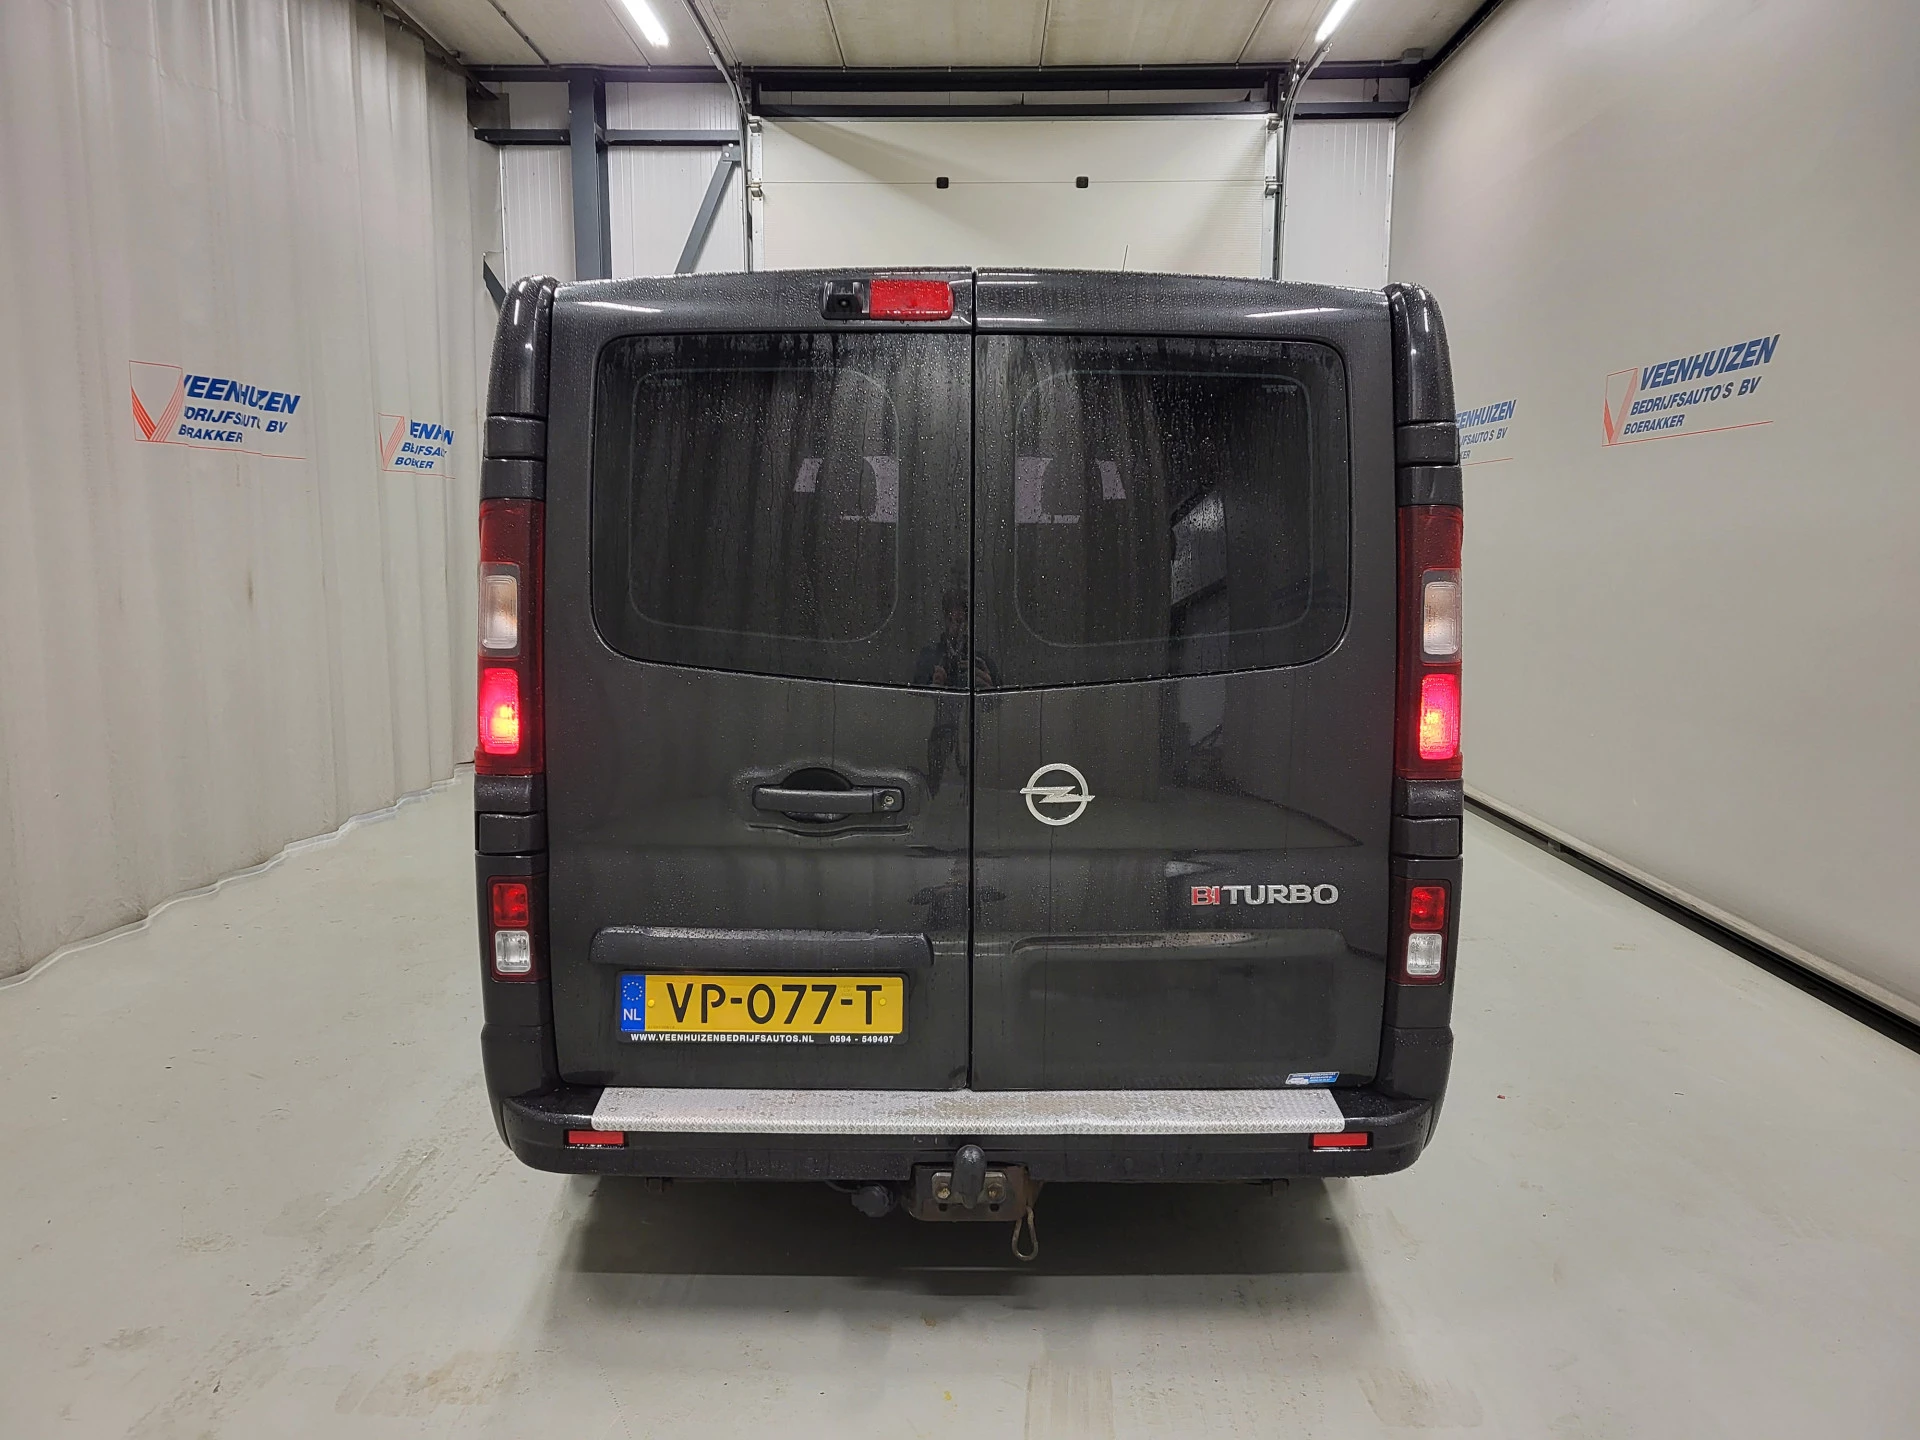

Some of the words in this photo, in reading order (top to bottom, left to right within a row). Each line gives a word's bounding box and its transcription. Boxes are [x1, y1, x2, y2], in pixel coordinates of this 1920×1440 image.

[1640, 334, 1780, 391] VEENHUIZEN
[1630, 382, 1734, 416] BEDRIJFSAUTO'S
[1737, 376, 1762, 397] BV
[265, 420, 288, 433] BV
[1496, 427, 1508, 439] BV
[1623, 414, 1685, 435] BOERAKKER
[666, 983, 882, 1025] VP-077-T
[623, 1009, 641, 1021] NL
[631, 1033, 814, 1043] WWW.VEENHUIZENBEDRIJFSAUTOS.NL
[830, 1035, 851, 1043] 0594
[861, 1035, 894, 1044] 549497
